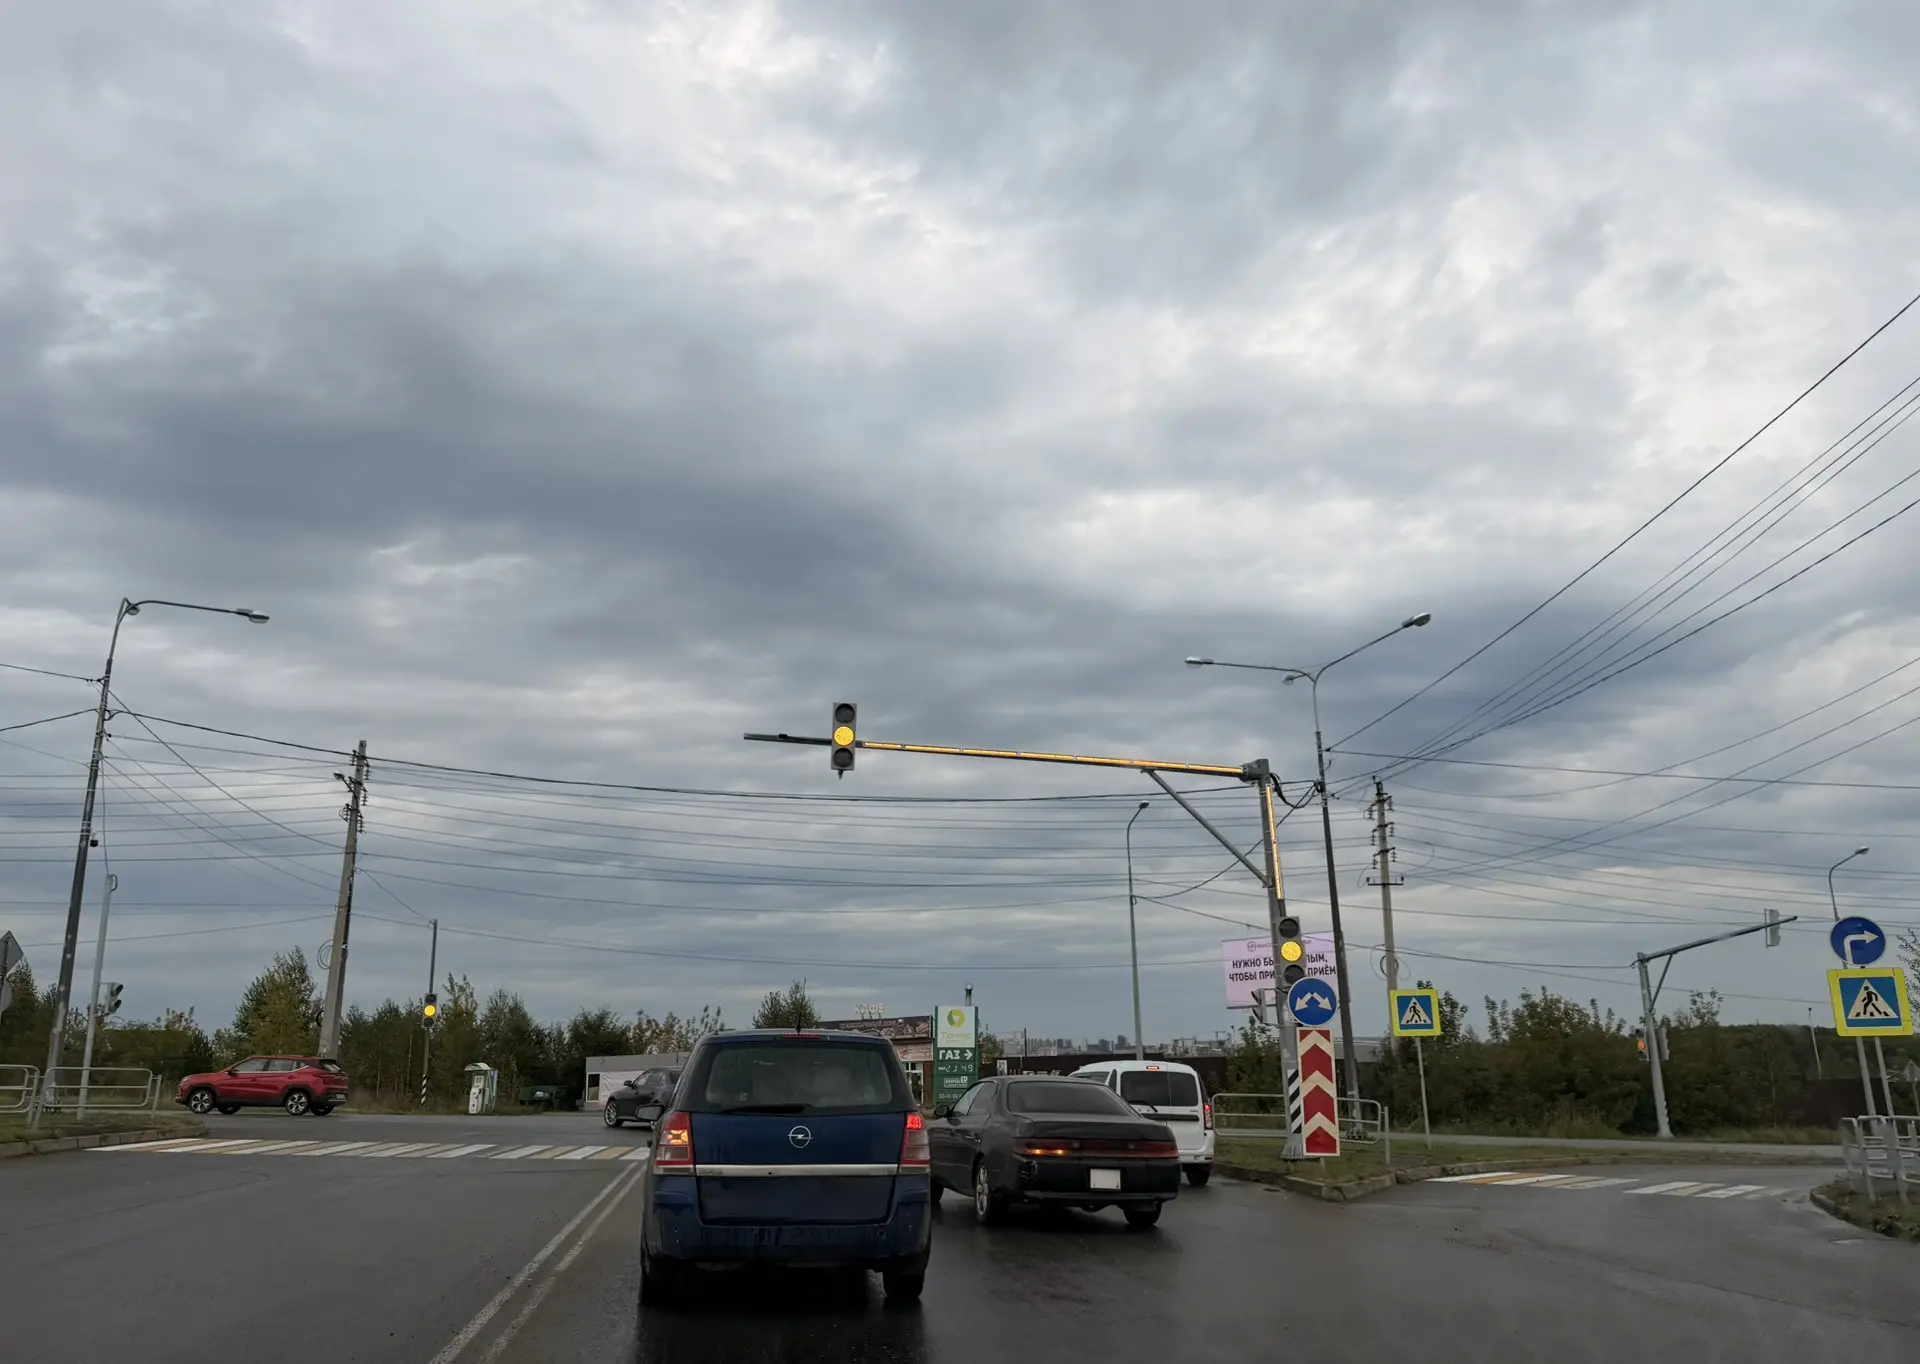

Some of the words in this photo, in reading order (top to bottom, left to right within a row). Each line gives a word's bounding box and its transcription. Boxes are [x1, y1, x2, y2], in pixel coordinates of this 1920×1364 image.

[1232, 958, 1261, 969] НУЖНО
[1229, 971, 1257, 982] ЧТОБЫ
[1259, 970, 1276, 980] ПРИ
[1307, 964, 1337, 977] ПРИЁМ
[938, 1050, 961, 1060] ГАЗ
